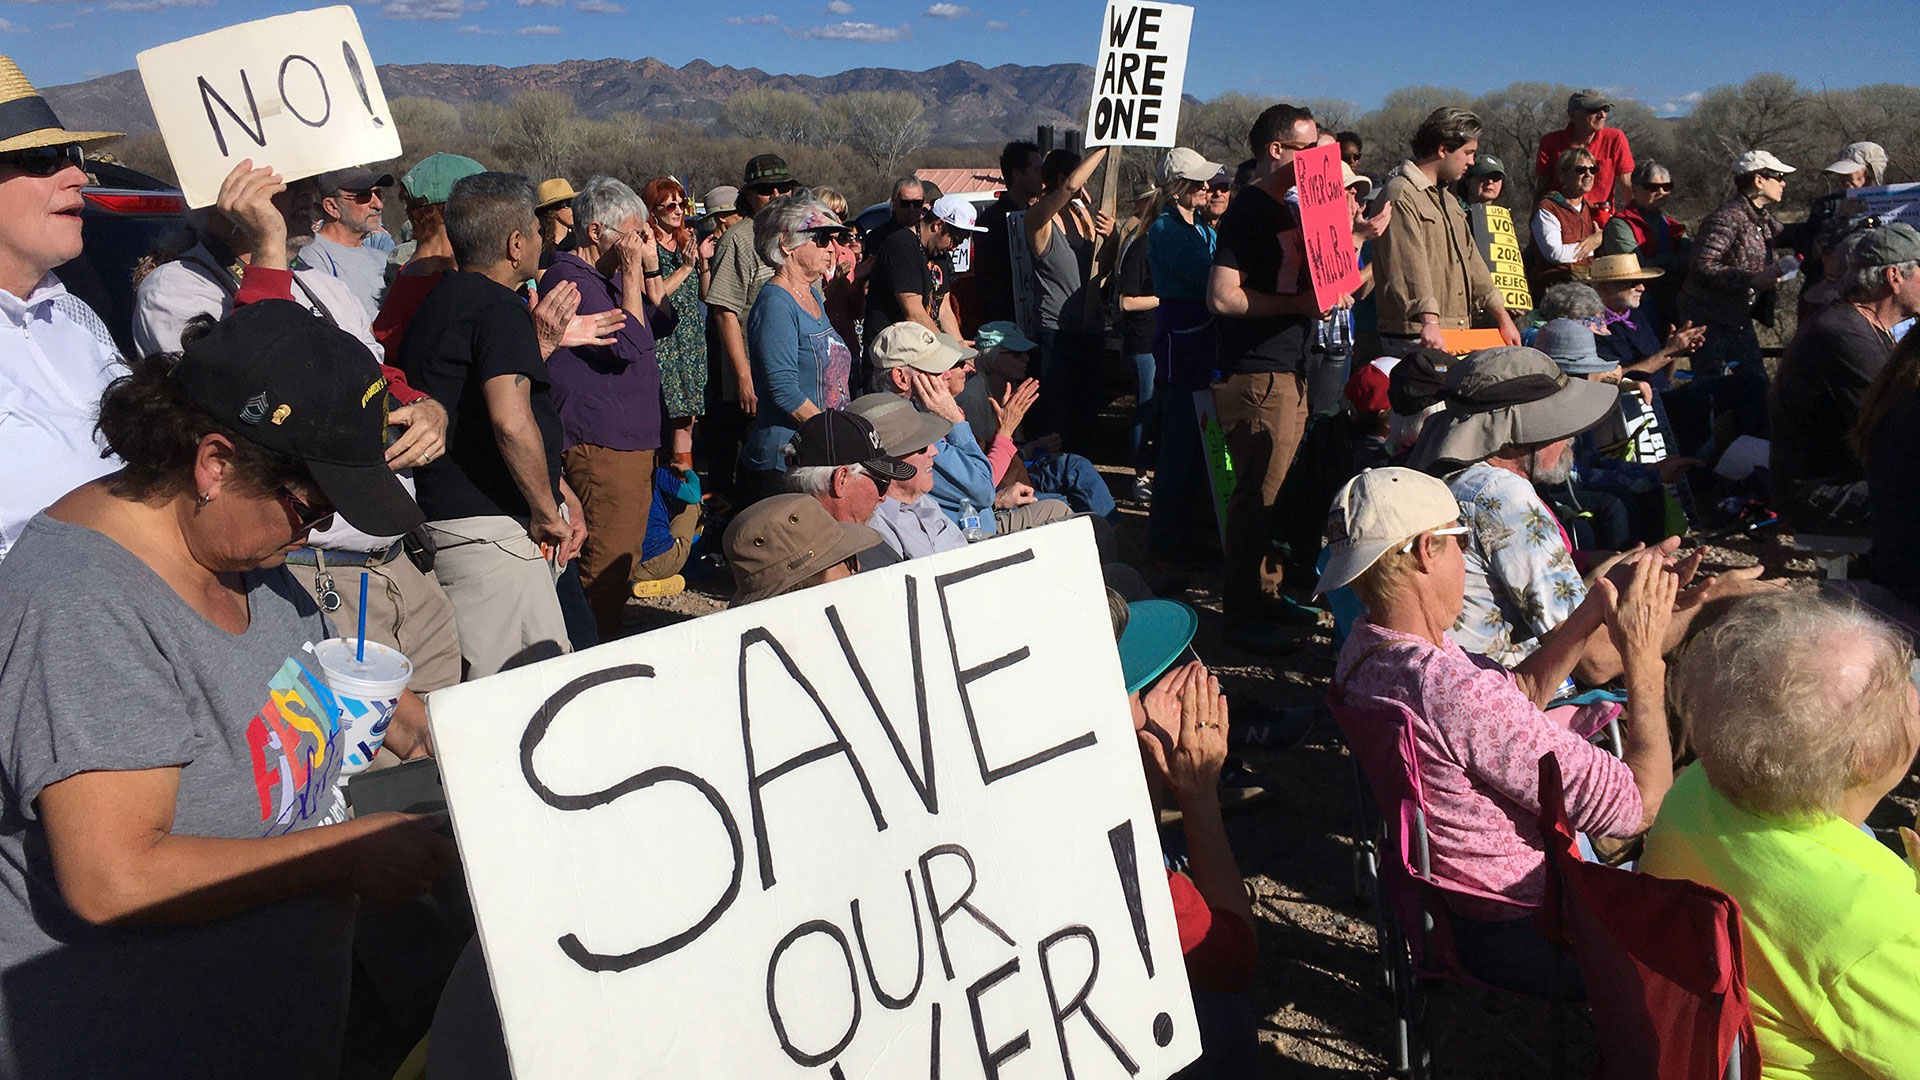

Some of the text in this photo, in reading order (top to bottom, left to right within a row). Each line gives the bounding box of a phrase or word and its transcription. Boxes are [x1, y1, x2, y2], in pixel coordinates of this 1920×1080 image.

[1109, 5, 1162, 50] WE
[1099, 52, 1168, 95] ARE
[197, 41, 384, 157] NO!
[1094, 97, 1162, 141] ONE
[1491, 208, 1503, 216] USE
[520, 548, 1098, 974] SAVE
[766, 844, 1017, 1068] OUR
